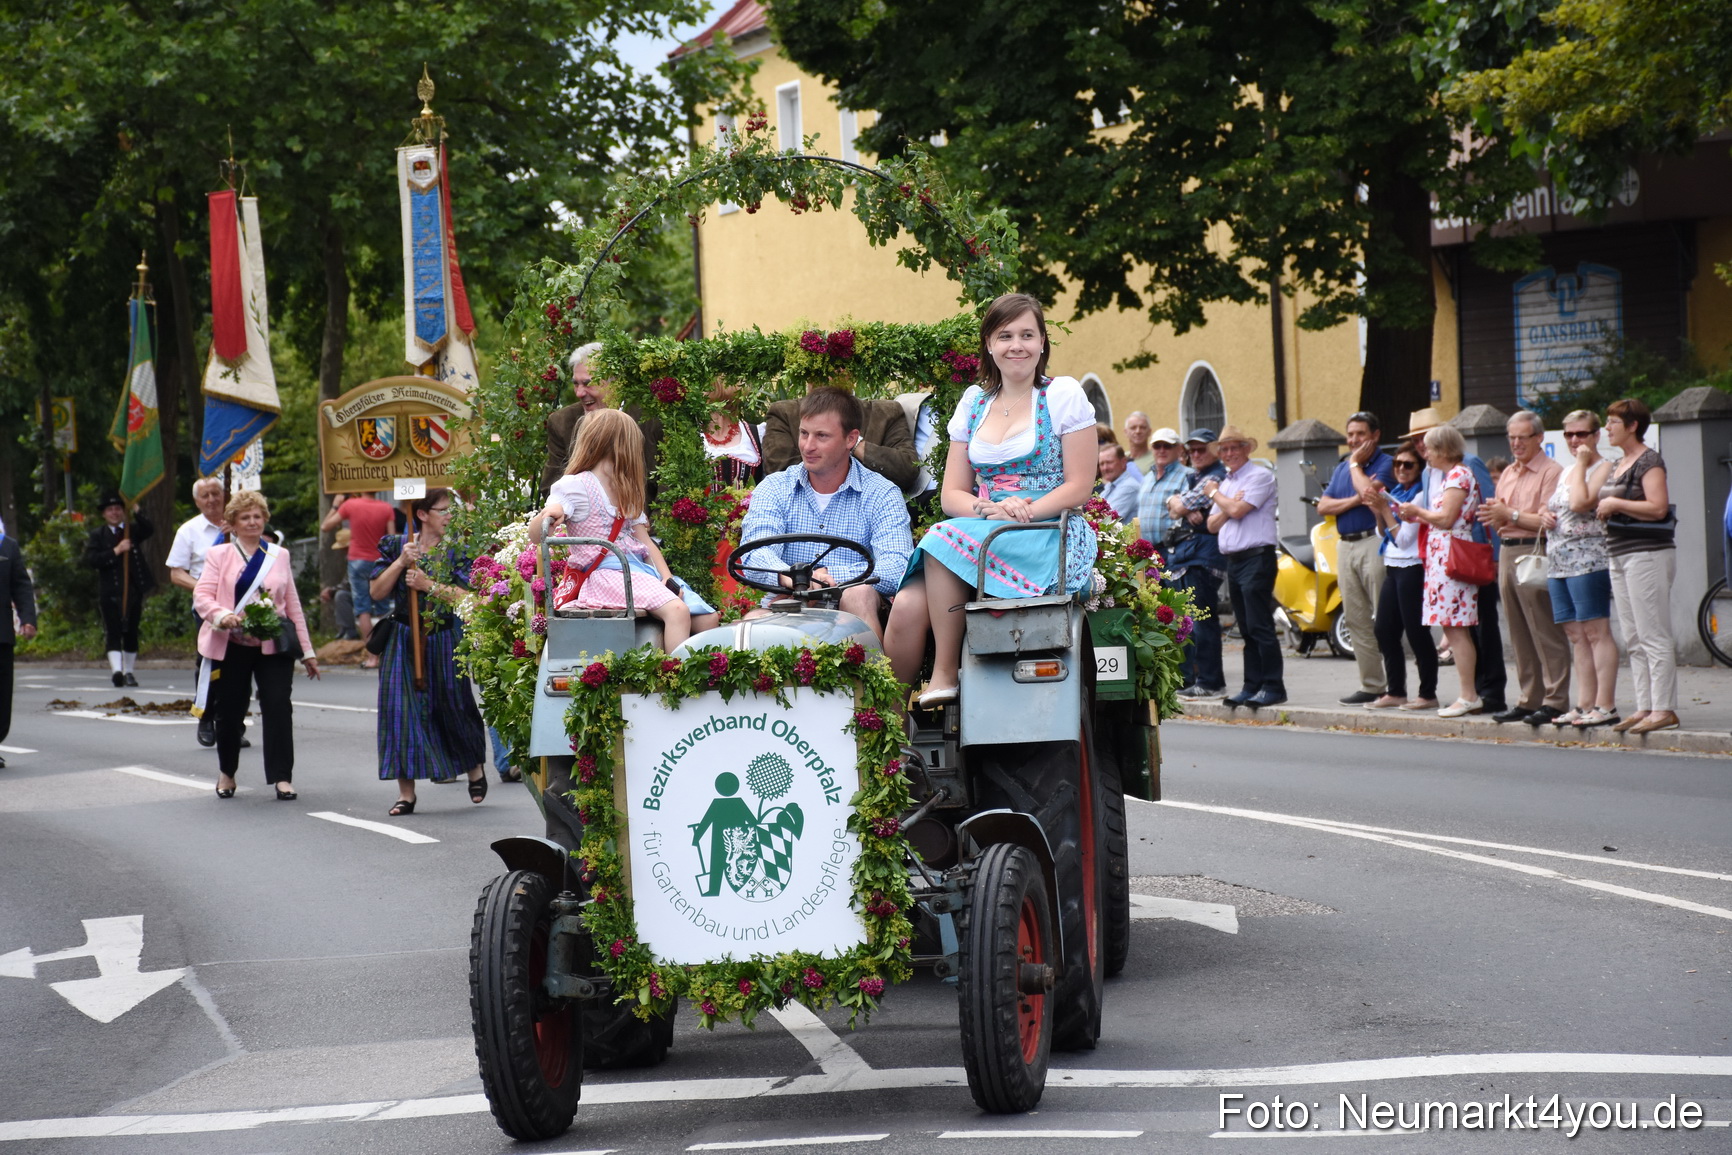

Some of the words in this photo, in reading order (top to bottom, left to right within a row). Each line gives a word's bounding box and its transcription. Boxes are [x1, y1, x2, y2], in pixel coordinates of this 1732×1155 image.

[335, 392, 386, 423] Oberpfälzer
[329, 462, 389, 482] Nürnberg
[400, 485, 415, 495] 30
[1097, 657, 1119, 673] 29
[643, 713, 767, 811] Bezirksverband
[771, 719, 842, 806] Oberpfalz
[643, 831, 662, 857] für
[772, 827, 850, 935] Landespflege
[652, 862, 728, 938] Gartenbau
[733, 920, 769, 941] und
